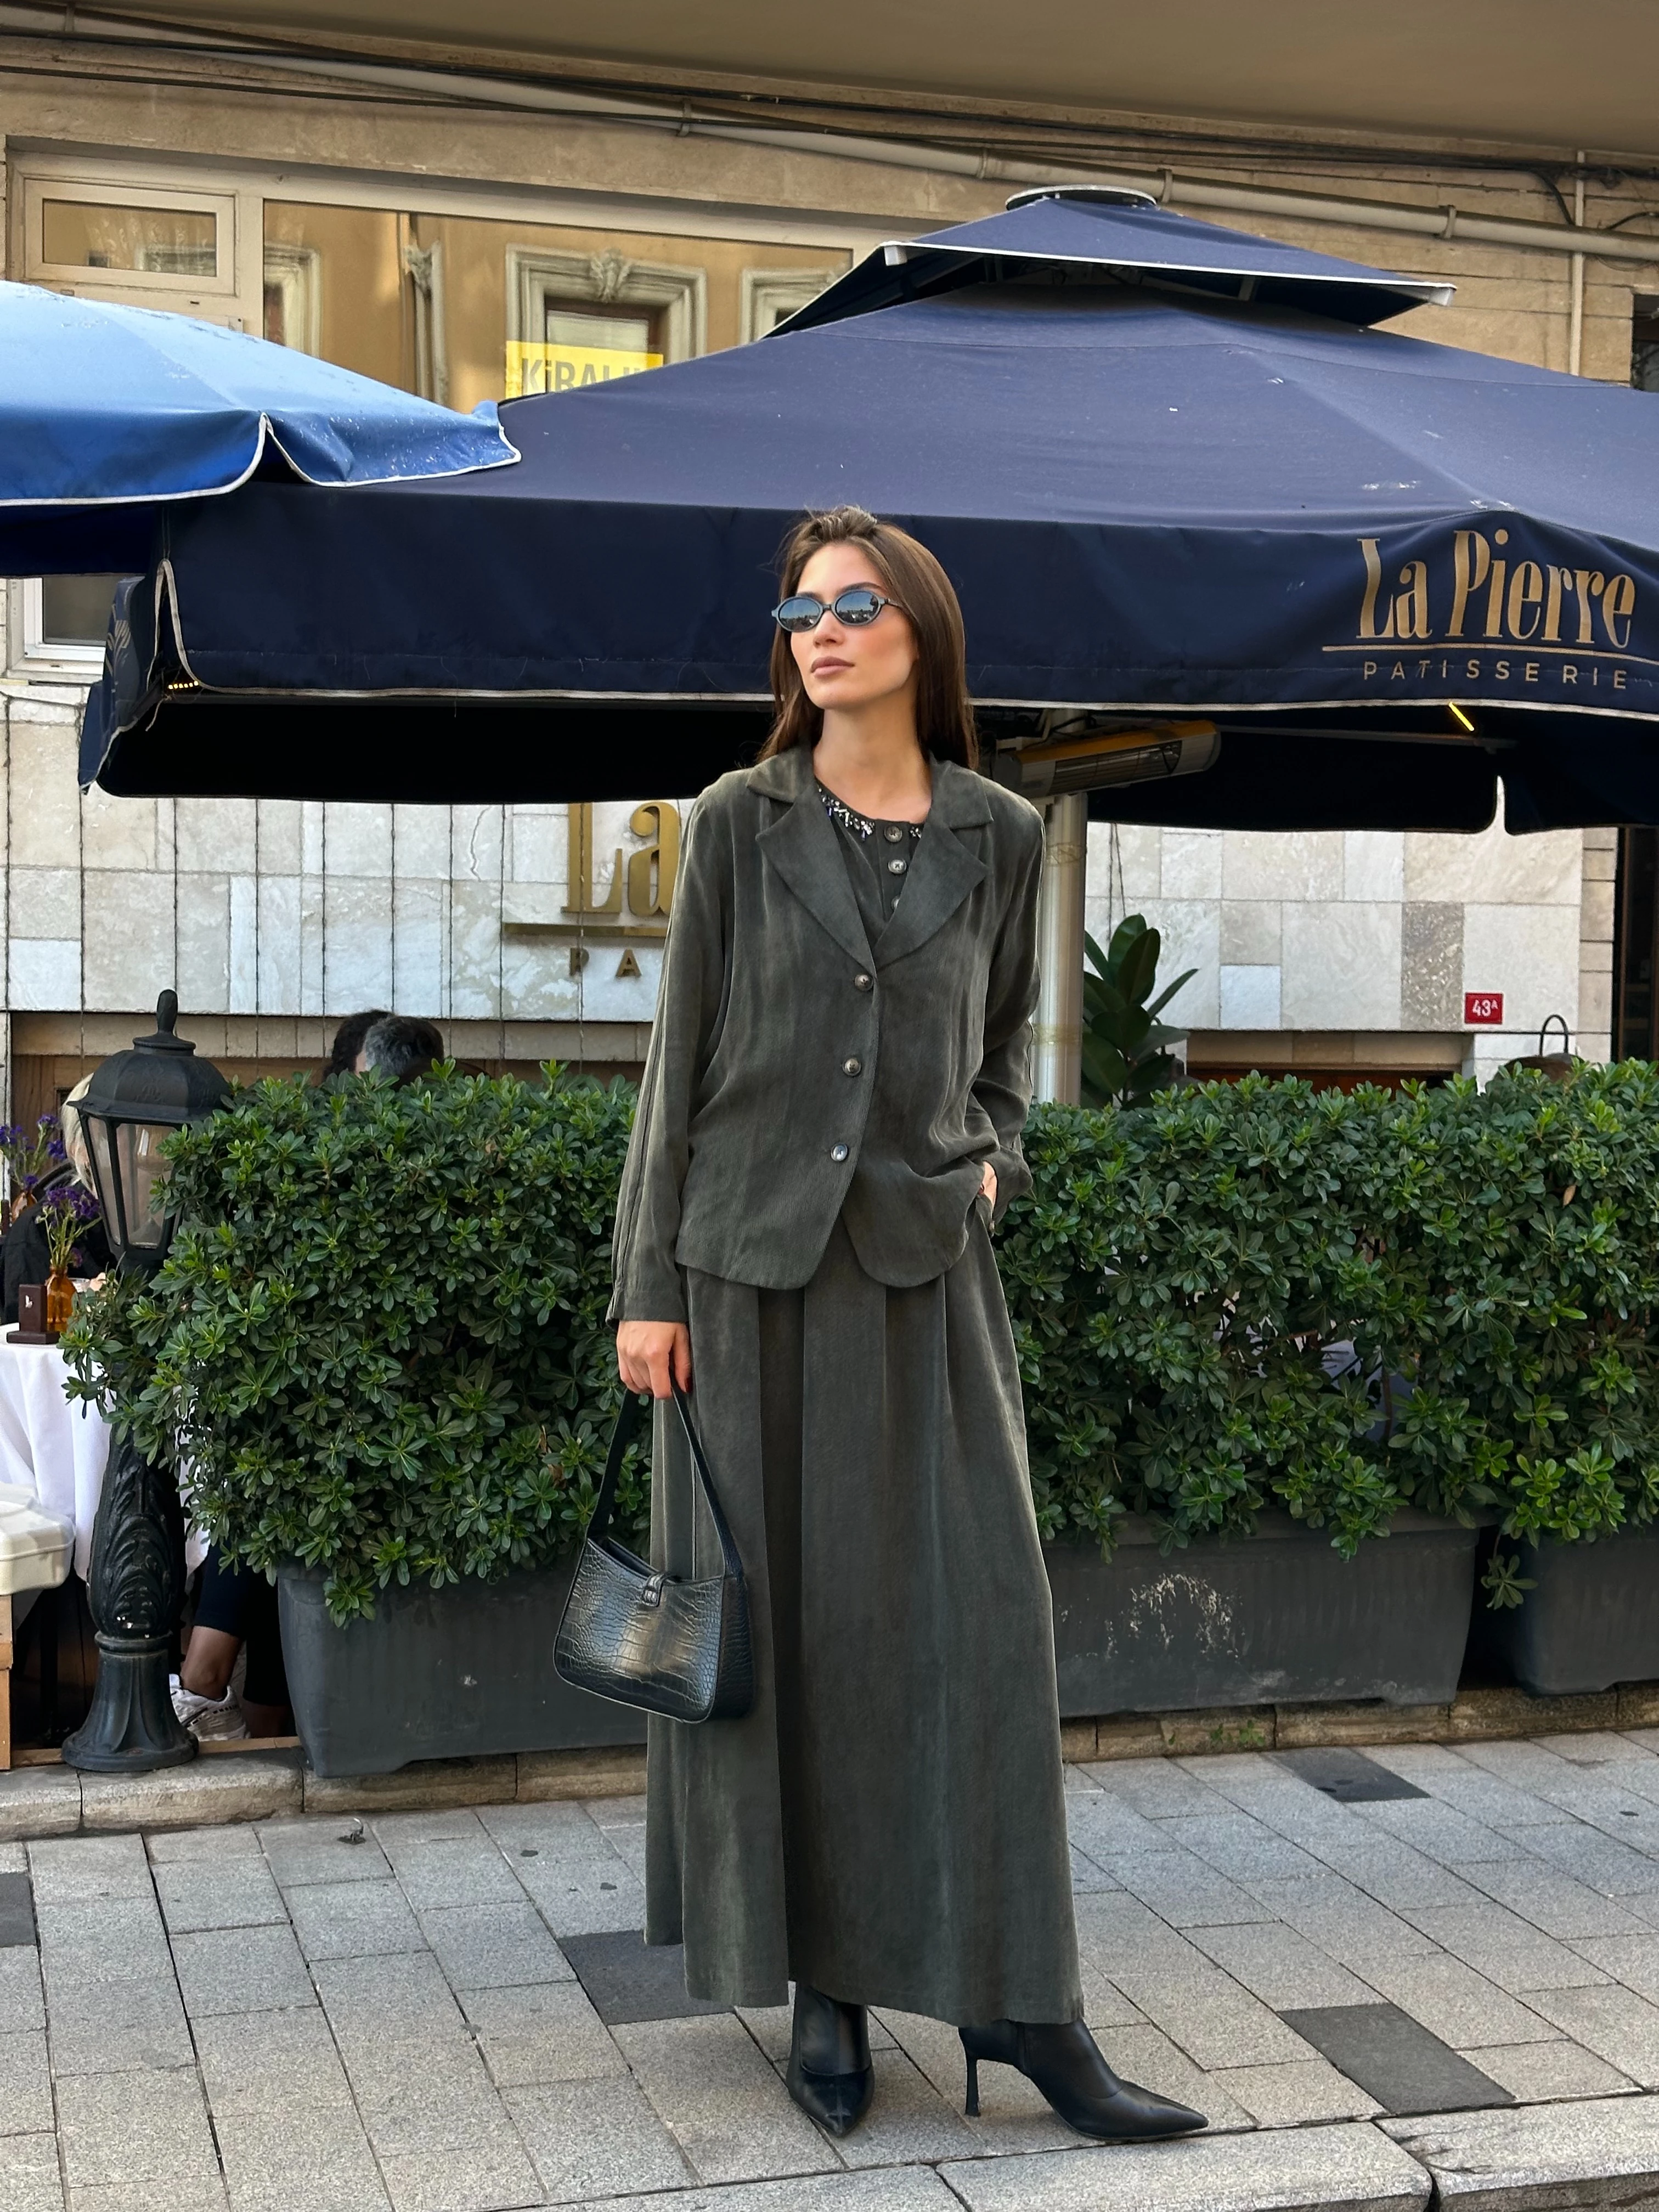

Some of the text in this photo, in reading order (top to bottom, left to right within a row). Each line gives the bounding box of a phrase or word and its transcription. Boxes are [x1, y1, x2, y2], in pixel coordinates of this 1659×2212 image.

[1356, 529, 1636, 649] La Pierre
[1363, 659, 1628, 689] PATISSERIE
[561, 802, 681, 917] La
